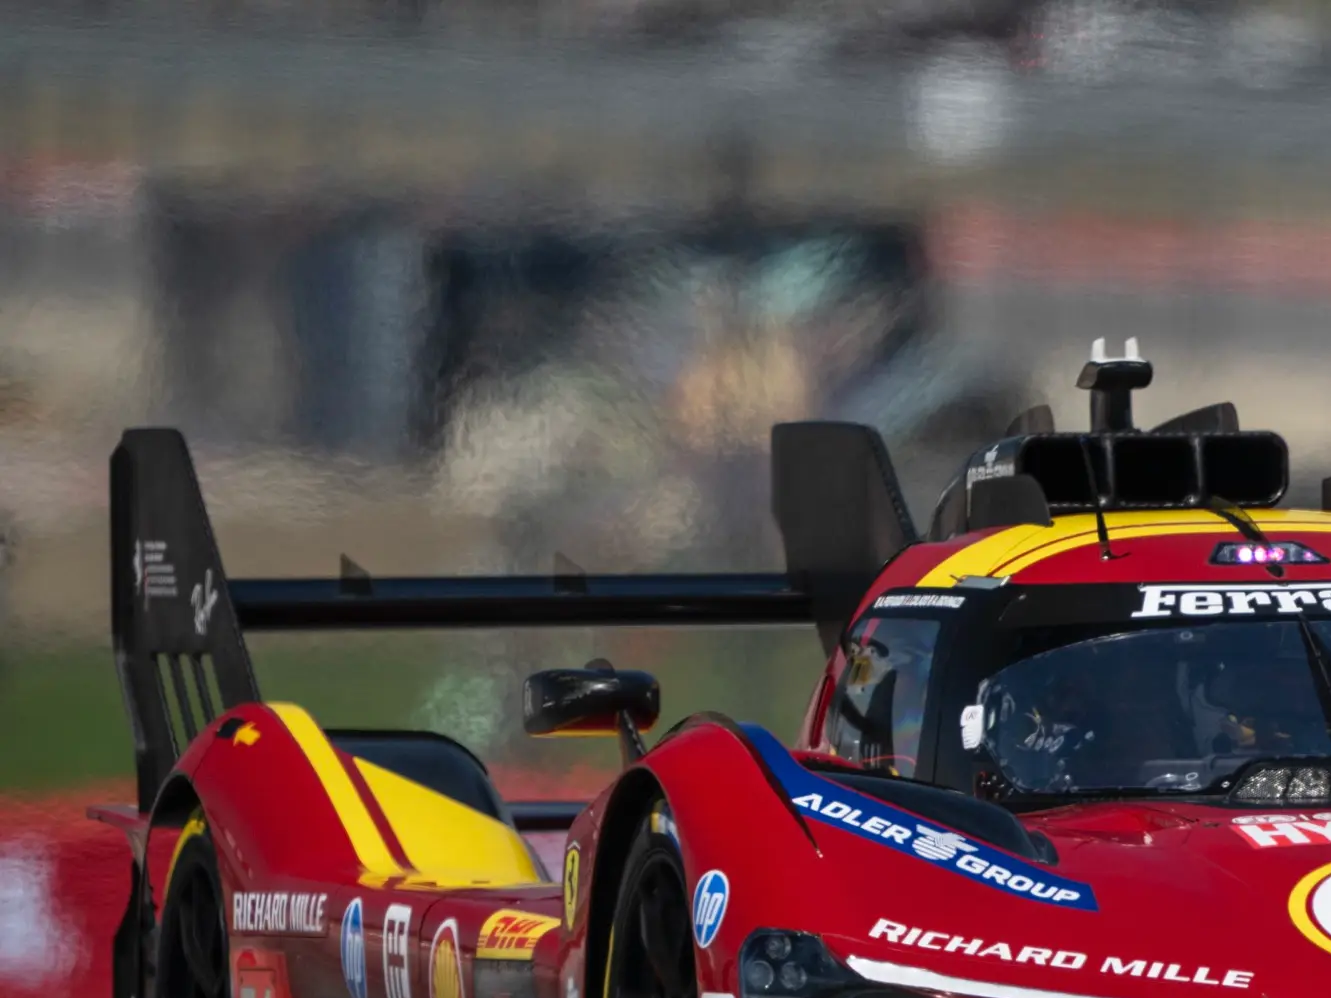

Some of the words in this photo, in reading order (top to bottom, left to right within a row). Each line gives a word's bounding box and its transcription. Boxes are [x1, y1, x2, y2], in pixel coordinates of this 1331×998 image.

[791, 793, 912, 844] ADLER
[955, 854, 1081, 902] GROUP
[232, 892, 287, 930] RICHARD
[289, 893, 328, 931] MILLE
[695, 873, 725, 946] hp
[868, 917, 1088, 970] RICHARD
[1099, 956, 1255, 988] MILLE
